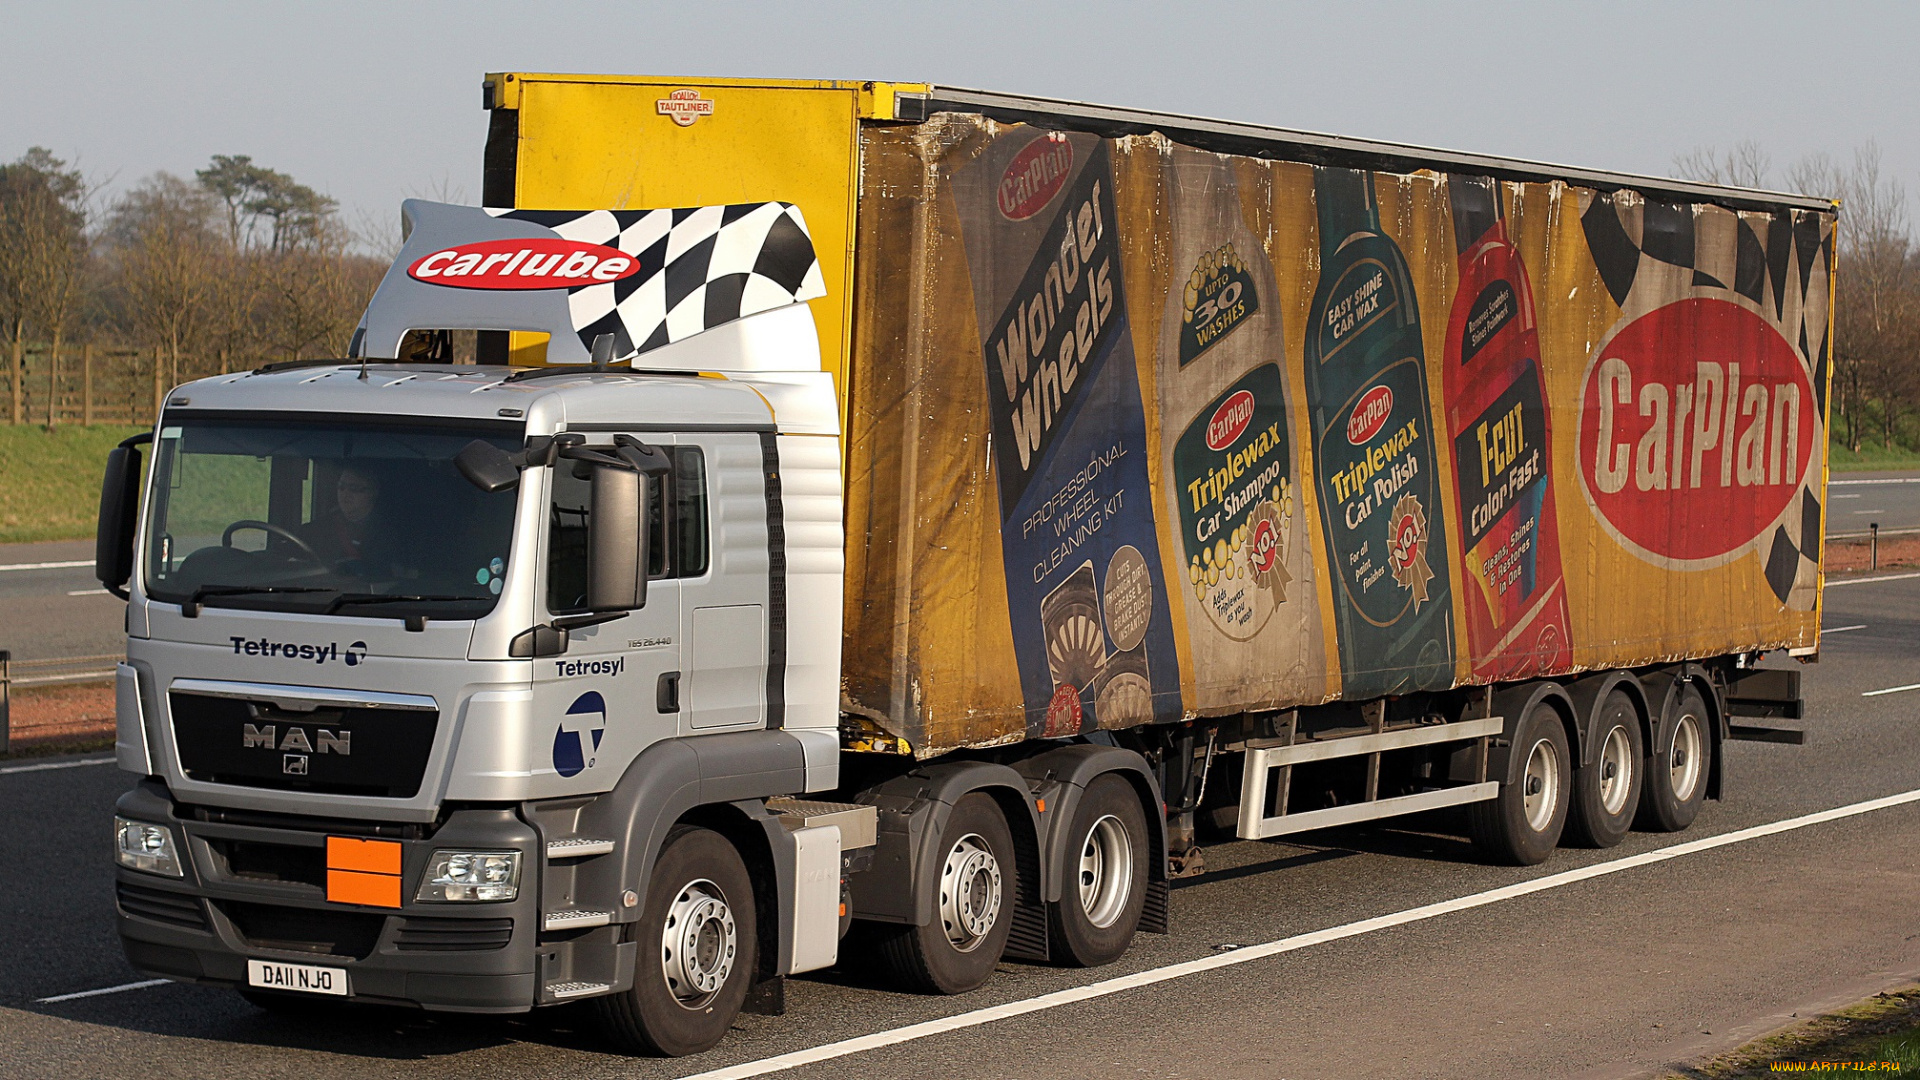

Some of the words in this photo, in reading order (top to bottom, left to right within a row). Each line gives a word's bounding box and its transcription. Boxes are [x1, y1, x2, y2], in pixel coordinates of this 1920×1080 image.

[660, 102, 709, 112] TAUTLINER
[1002, 144, 1069, 213] CarPlan
[416, 249, 631, 280] Carlube
[996, 179, 1103, 402] Wonder
[1194, 281, 1243, 330] 30
[1328, 295, 1352, 326] EASY
[1354, 271, 1383, 305] SHINE
[1196, 300, 1245, 346] WASHES
[1333, 314, 1354, 340] CAR
[1355, 293, 1379, 322] WAX
[1011, 255, 1113, 471] Wheels
[1209, 397, 1251, 447] CarPlan
[1349, 392, 1390, 440] CarPlan
[1594, 357, 1800, 494] CarPlan
[1187, 421, 1281, 514] Triplewax
[1330, 417, 1419, 505] Triplewax
[1477, 401, 1524, 488] T-CUT
[1022, 441, 1128, 540] PROFESSIONAL
[1053, 488, 1100, 537] WHEEL
[1196, 511, 1221, 542] Car
[1224, 460, 1280, 521] Shampoo
[1345, 494, 1373, 530] Car
[1373, 452, 1418, 507] Polish
[1471, 483, 1508, 537] Color
[1509, 448, 1539, 500] Fast
[1033, 511, 1102, 584] CLEANING
[1104, 489, 1124, 520] KIT
[1350, 551, 1360, 566] For
[1360, 540, 1368, 556] all
[1483, 545, 1509, 577] Cleans,
[1510, 516, 1534, 548] Shines
[1116, 559, 1130, 580] CUTS
[1355, 558, 1371, 582] paint
[1363, 565, 1385, 594] finishes
[1490, 572, 1496, 587] &
[1497, 538, 1531, 580] Restores
[1508, 564, 1522, 586] One
[1106, 575, 1131, 606] THROUGH
[1113, 606, 1132, 632] BRAKE
[1133, 592, 1147, 614] DUST
[1114, 586, 1136, 614] GREASE
[1213, 588, 1227, 608] Adds
[1217, 588, 1244, 617] Triplewax
[1227, 612, 1233, 623] as
[1234, 602, 1245, 620] you
[1118, 609, 1147, 643] INSTANTLY
[1239, 607, 1252, 626] wash
[230, 636, 337, 665] Tetrosyl
[555, 656, 624, 677] Tetrosyl
[243, 723, 350, 755] MAN
[262, 965, 293, 986] DA11
[298, 968, 331, 990] NJO
